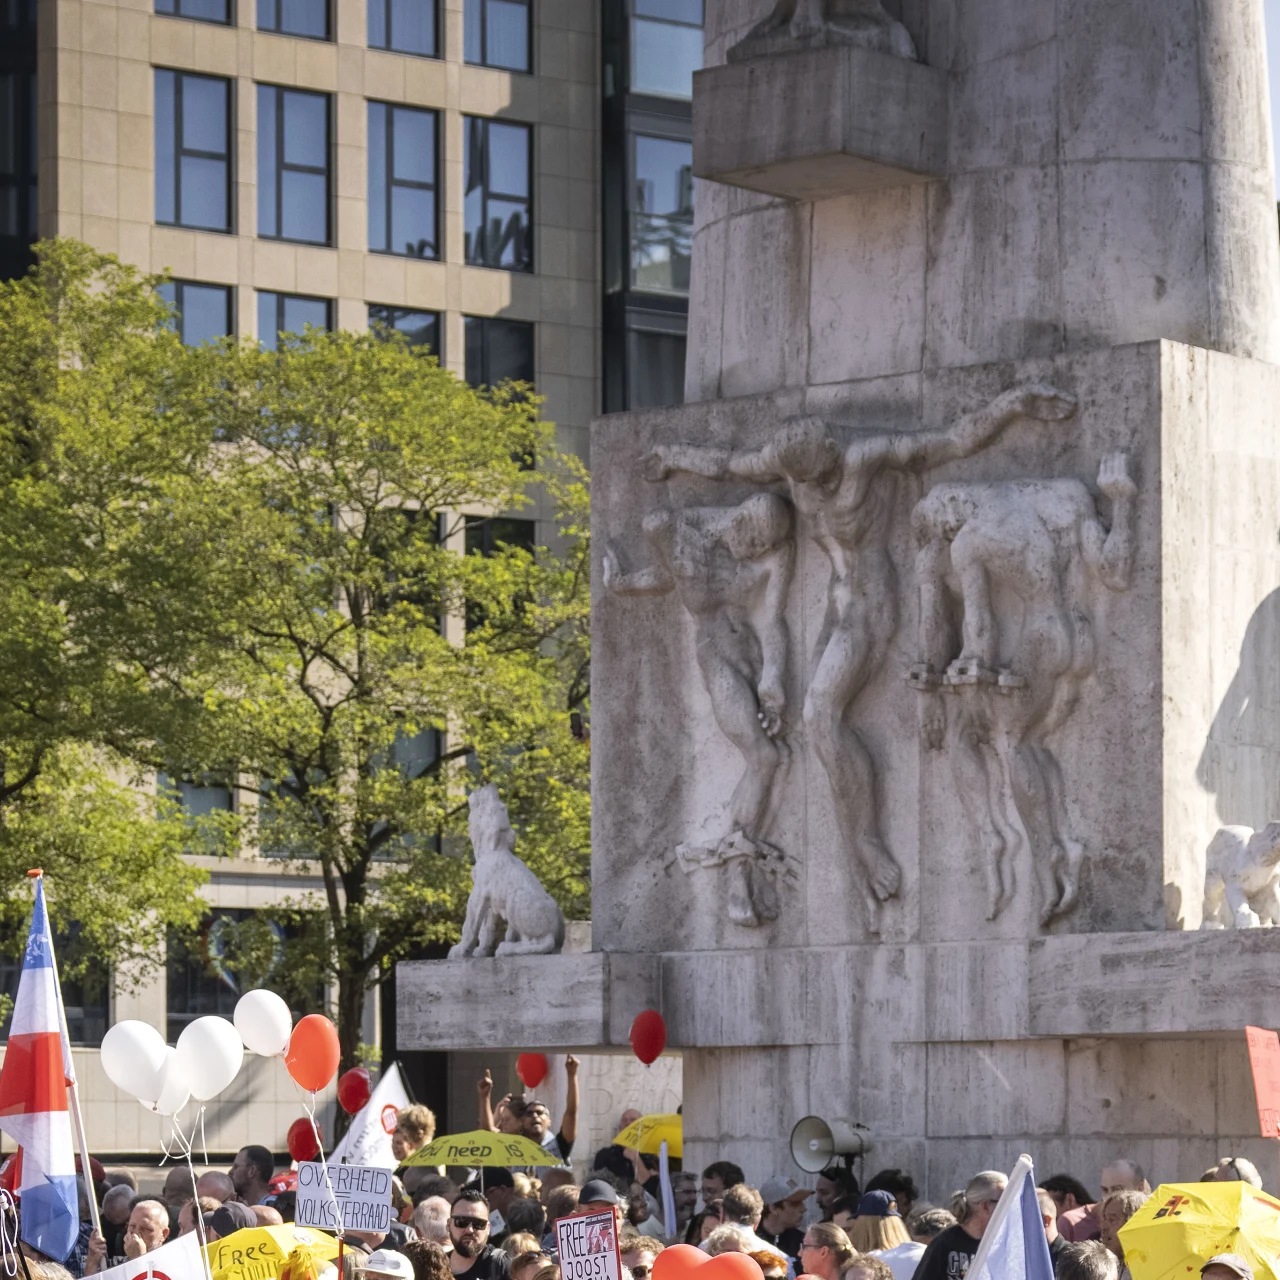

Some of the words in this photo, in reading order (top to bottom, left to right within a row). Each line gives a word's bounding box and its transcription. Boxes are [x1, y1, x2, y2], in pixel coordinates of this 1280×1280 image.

[299, 1164, 389, 1195] OVERHEID
[296, 1197, 389, 1230] VOLKSVERRAAD
[559, 1220, 587, 1260] FREE
